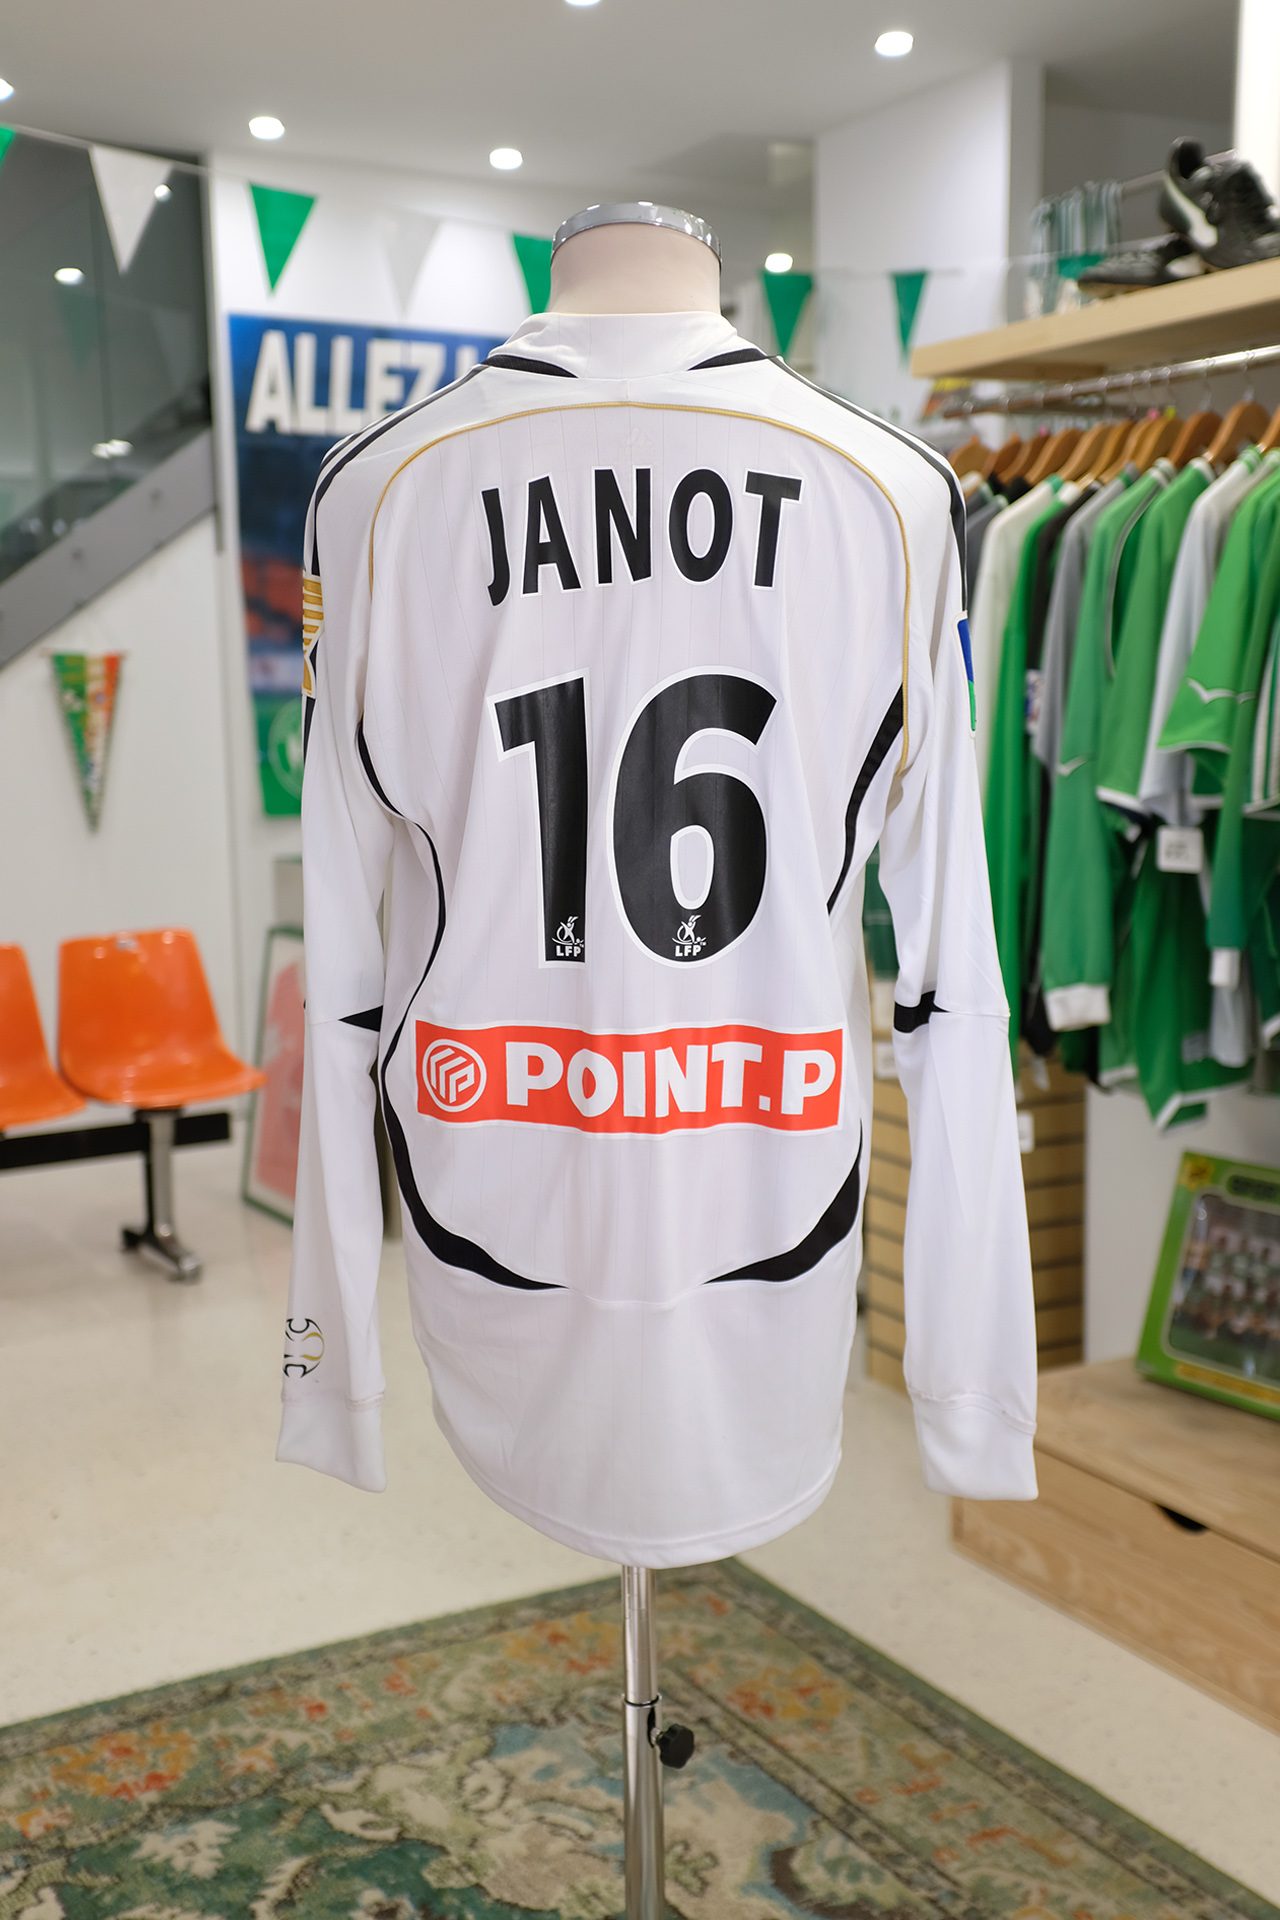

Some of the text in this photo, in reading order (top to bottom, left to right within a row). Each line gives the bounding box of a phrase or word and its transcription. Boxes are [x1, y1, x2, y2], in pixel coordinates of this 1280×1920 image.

[245, 329, 447, 436] ALLEZ
[480, 467, 803, 607] JANOT
[492, 672, 778, 963] 16
[555, 945, 582, 957] LFP
[675, 944, 702, 957] LFP
[505, 1041, 836, 1118] POINT.P
